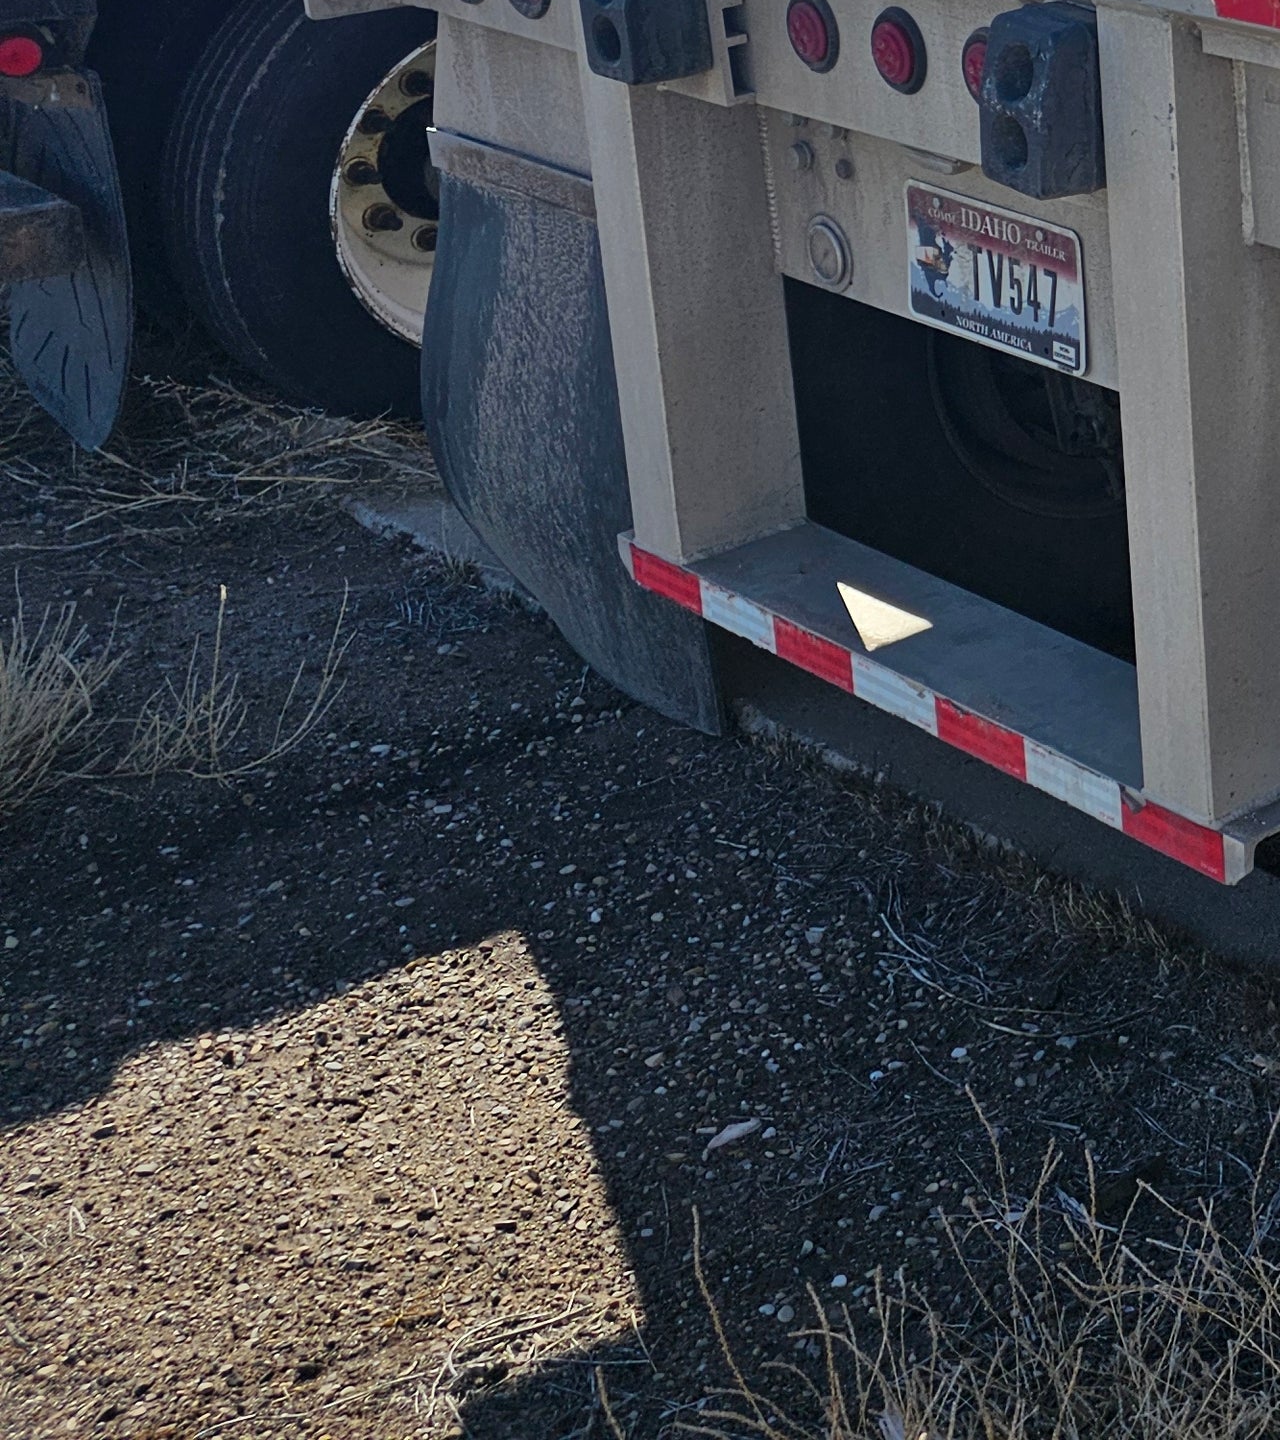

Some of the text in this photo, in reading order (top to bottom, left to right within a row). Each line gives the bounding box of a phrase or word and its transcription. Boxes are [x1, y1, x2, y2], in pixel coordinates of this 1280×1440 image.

[960, 207, 1021, 245] IDAHO
[1024, 238, 1066, 262] TRAILER
[967, 243, 1058, 328] TV547
[956, 317, 1033, 353] NORTH AMERICA
